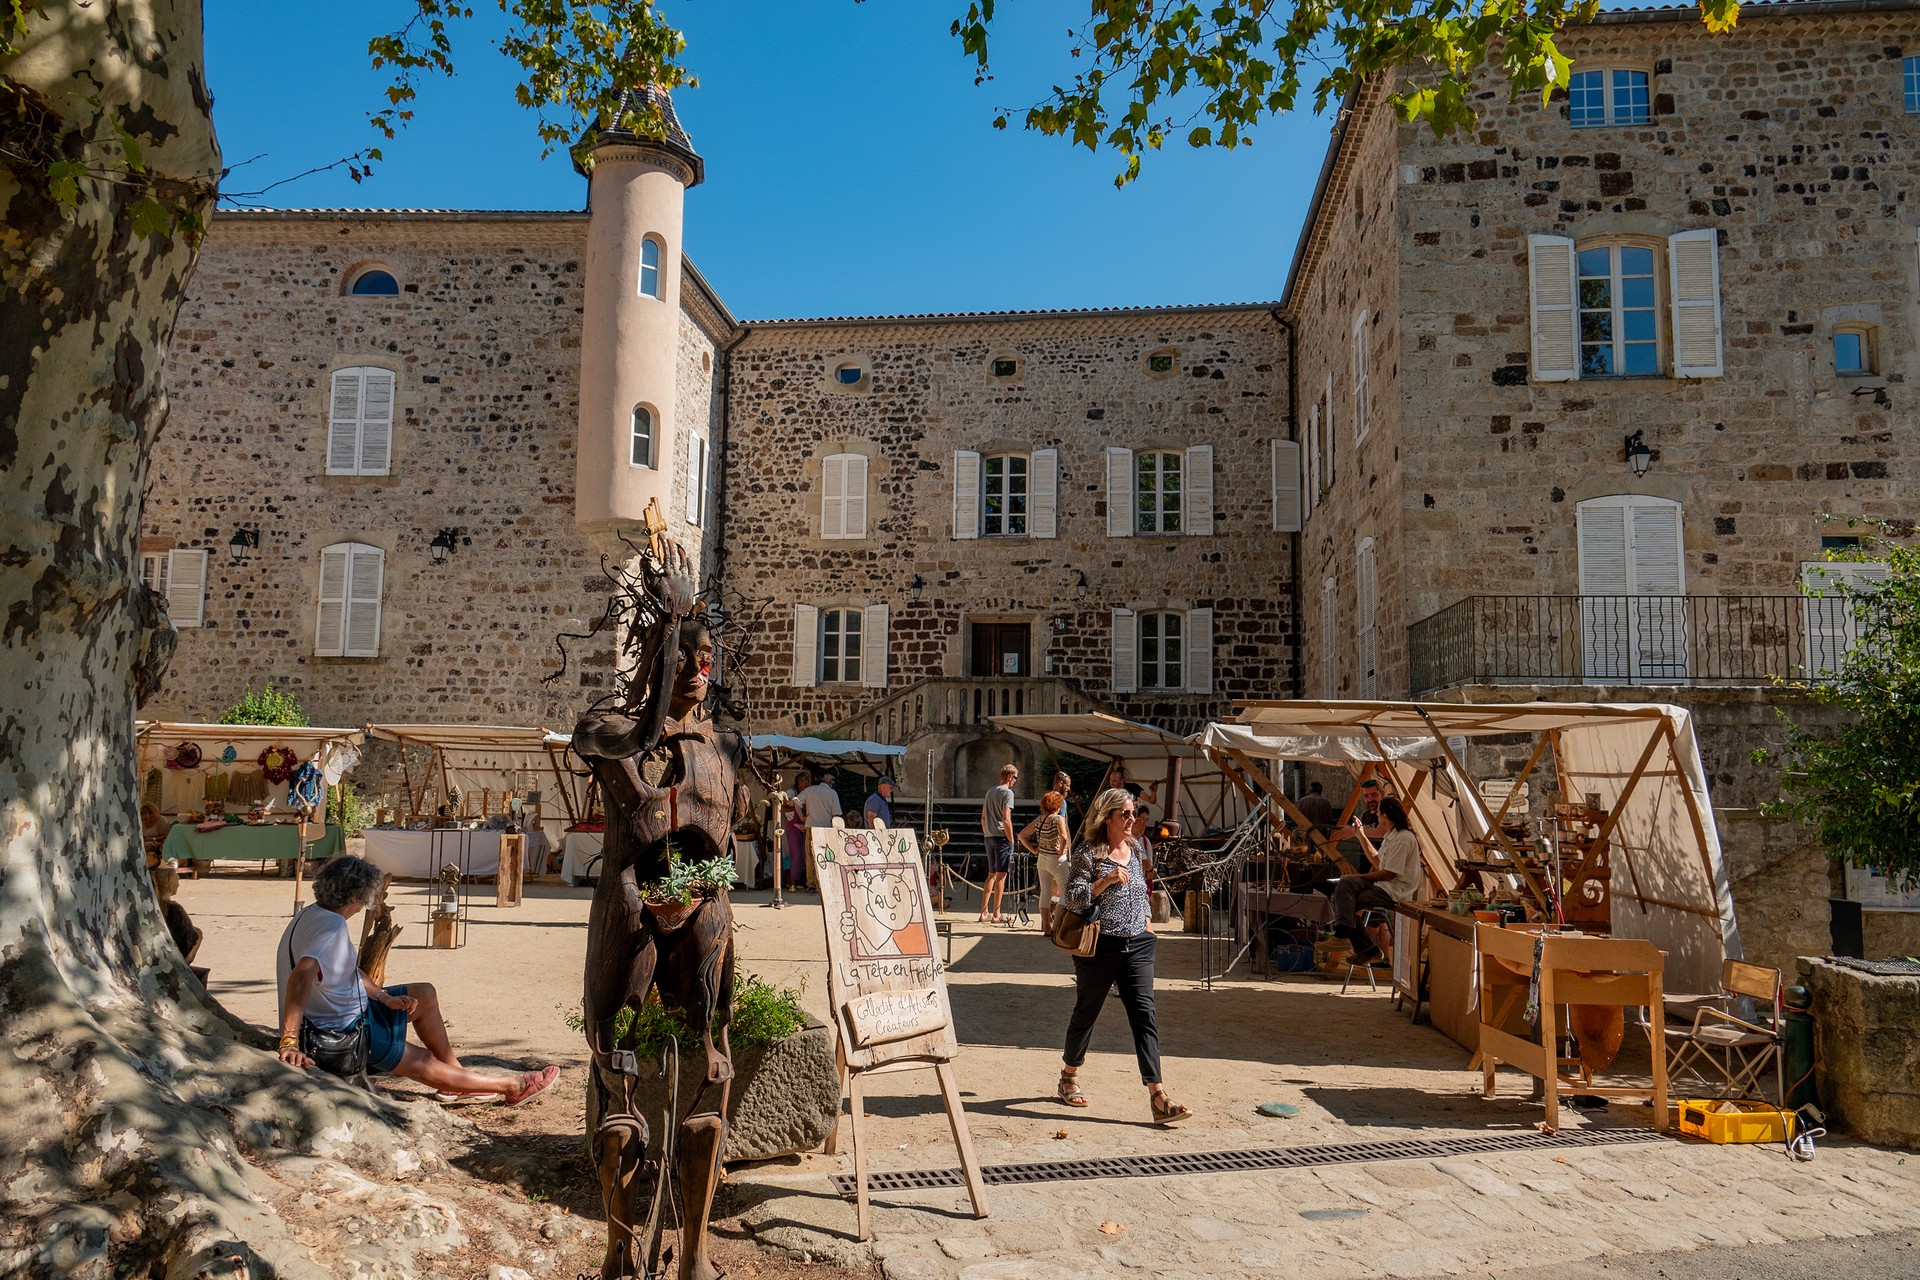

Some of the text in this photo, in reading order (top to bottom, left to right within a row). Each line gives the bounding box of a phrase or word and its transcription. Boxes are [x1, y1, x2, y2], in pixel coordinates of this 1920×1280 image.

[839, 958, 943, 987] La Tête en Friche
[856, 995, 894, 1021] Collectif
[875, 1016, 919, 1036] Créateurs
